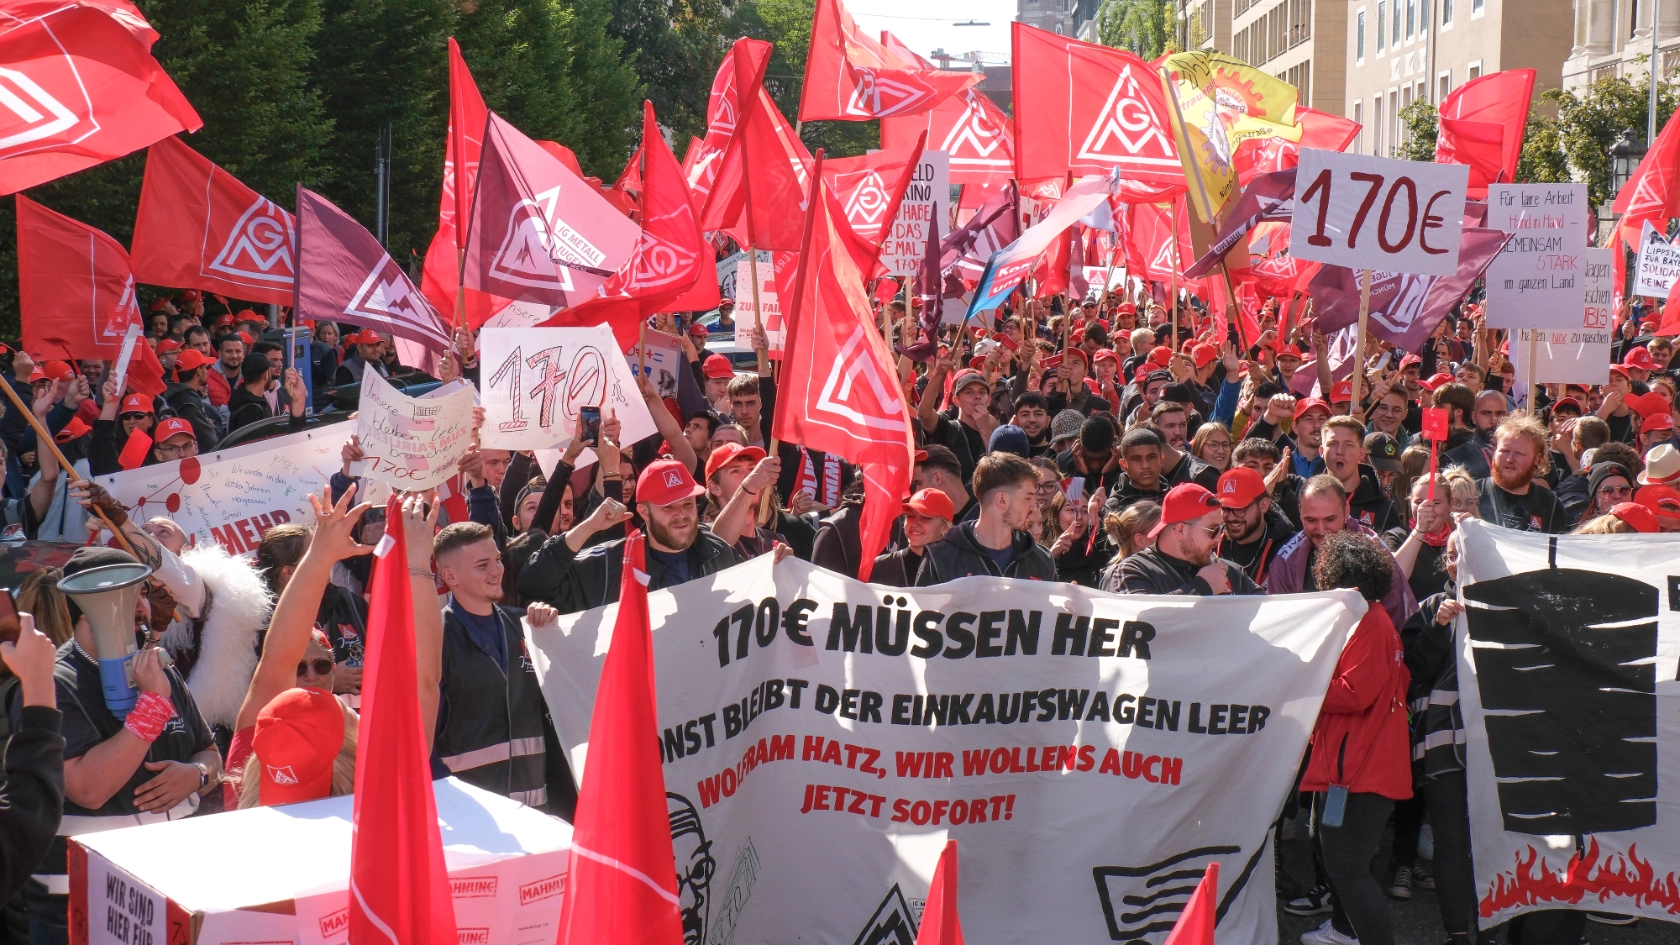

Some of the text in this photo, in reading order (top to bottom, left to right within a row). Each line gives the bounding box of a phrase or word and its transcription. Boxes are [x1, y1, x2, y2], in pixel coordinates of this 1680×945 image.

[1300, 168, 1452, 255] 170€
[1500, 190, 1516, 206] Für
[1544, 190, 1575, 205] Arbeit
[903, 204, 931, 222] HABE
[1509, 213, 1532, 229] Hand
[1543, 213, 1565, 229] Hand
[557, 225, 602, 264] IG METALL
[896, 223, 922, 240] DAS
[1536, 254, 1578, 271] STARK
[1519, 278, 1548, 293] ganzen
[1551, 274, 1575, 289] Land
[1641, 276, 1669, 290] KEINE
[1551, 332, 1568, 344] NIX
[713, 594, 1157, 668] 170€ MÜSSEN HER
[722, 678, 809, 740] BLEIBT
[814, 683, 884, 724] DER
[890, 688, 1182, 733] EINKAUFSWAGEN
[1187, 701, 1271, 735] LEER
[697, 734, 1184, 810] WOLFRAM HATZ, WIR WOLLENS AUCH
[800, 784, 1016, 826] JETZT SOFORT!
[106, 871, 127, 909] WIR
[128, 886, 154, 927] SIND
[106, 904, 130, 945] HIER
